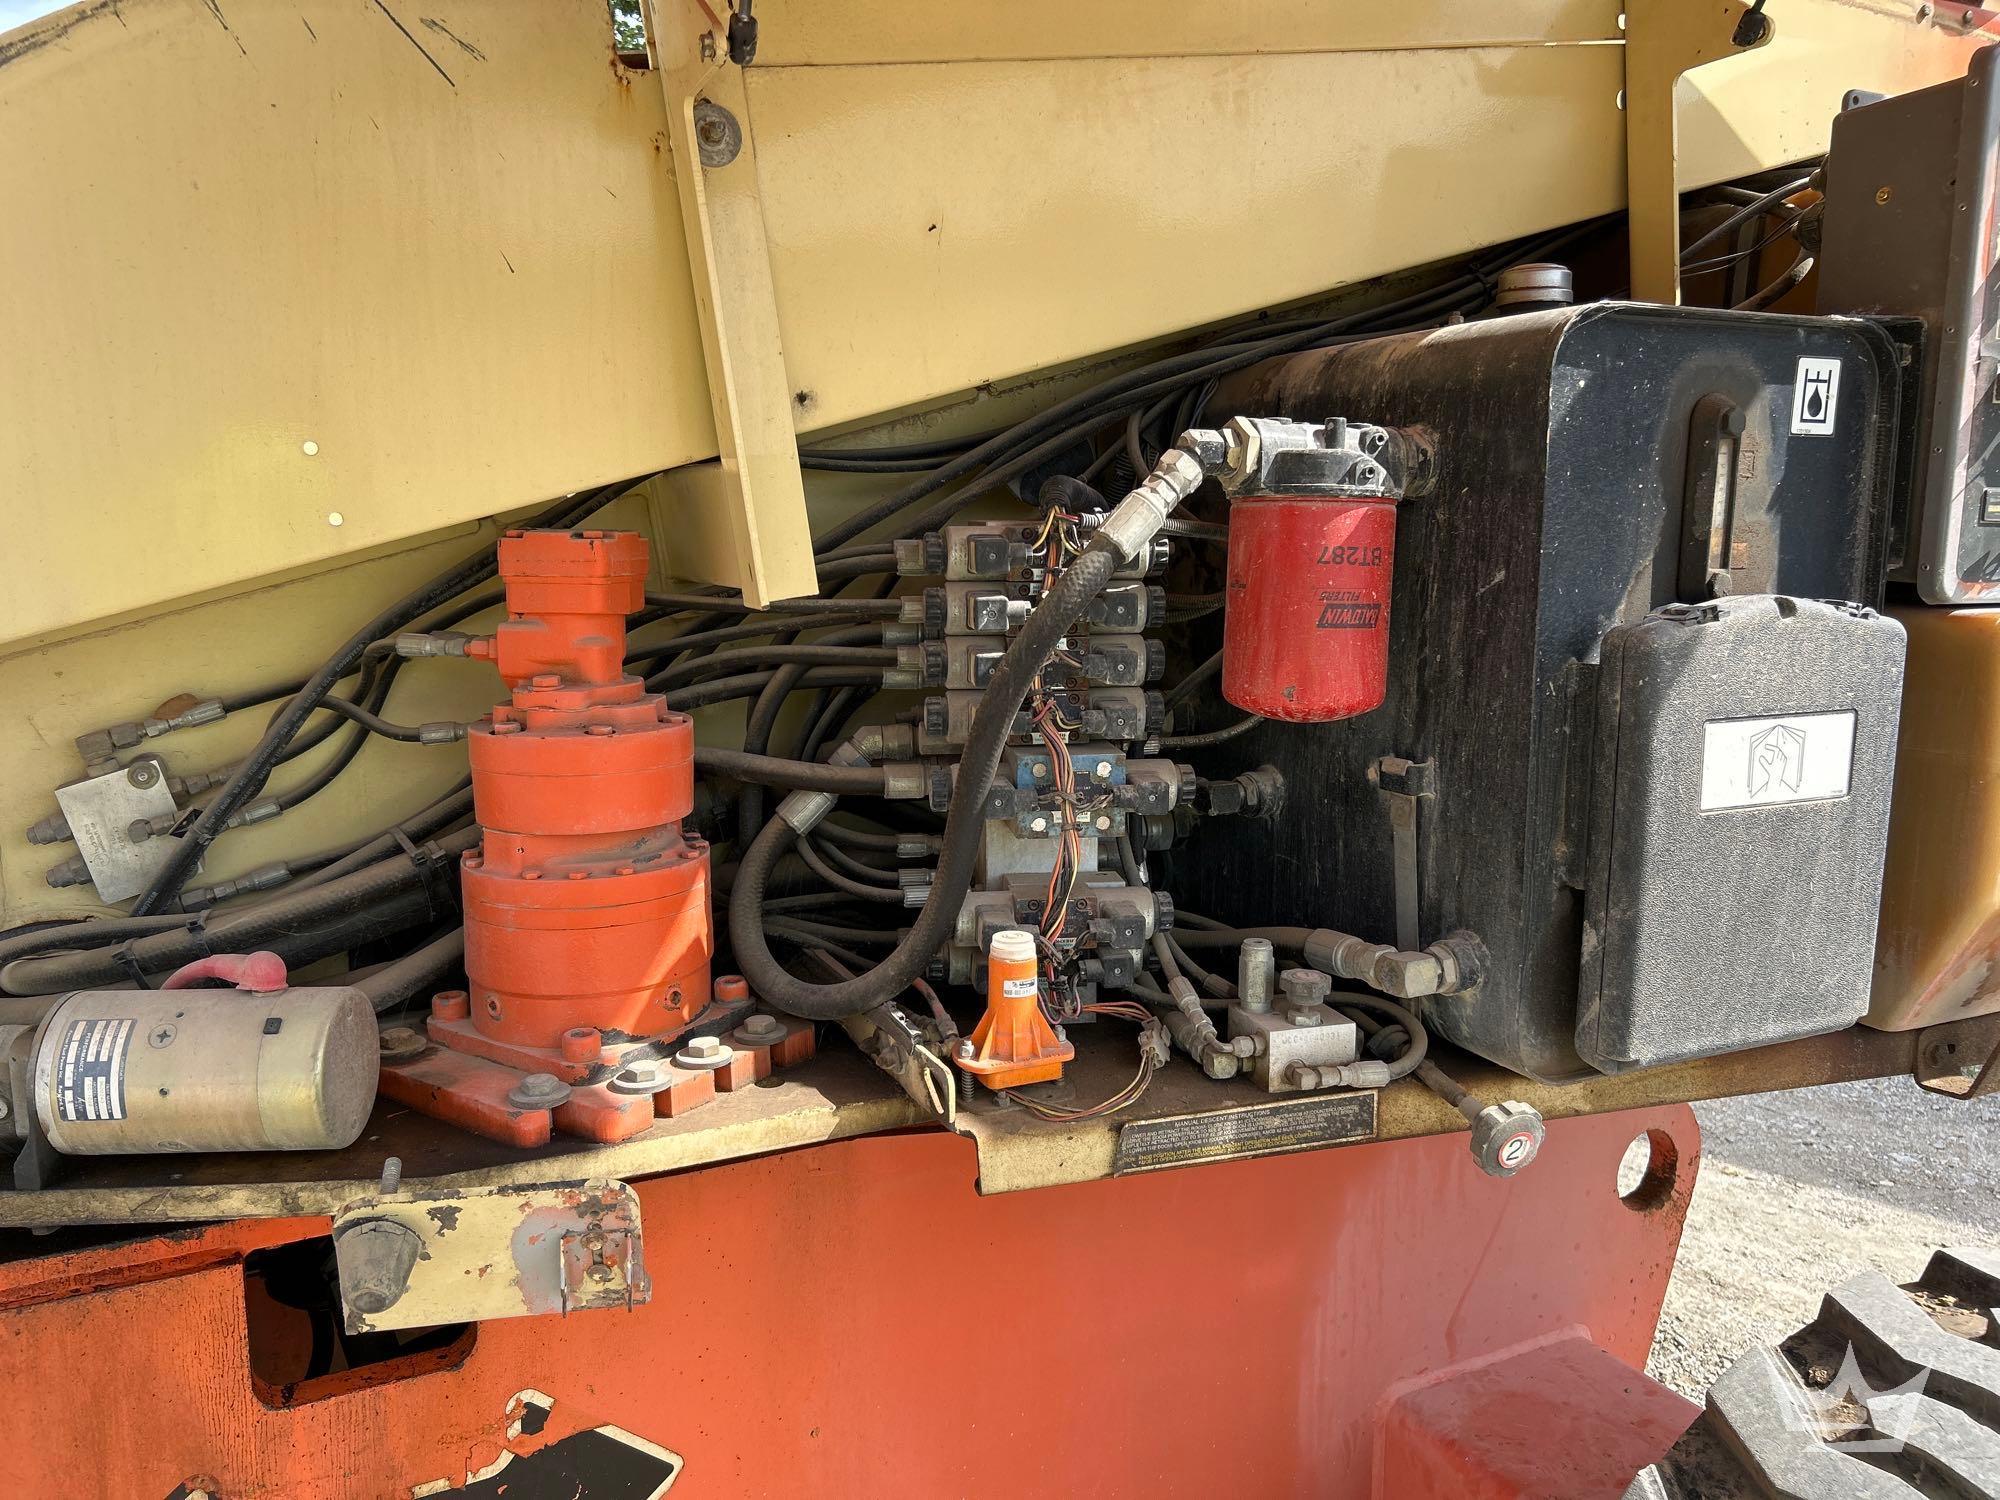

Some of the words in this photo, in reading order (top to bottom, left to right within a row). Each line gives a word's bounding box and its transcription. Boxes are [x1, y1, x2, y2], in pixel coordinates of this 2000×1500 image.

[1317, 545, 1382, 566] BT287
[1319, 591, 1361, 602] FILTERS
[1322, 607, 1379, 625] BALDWIN
[79, 1032, 91, 1072] PERFORMANCE
[1174, 1118, 1199, 1126] MANUAL
[1200, 1114, 1226, 1123] DESCENT
[1228, 1109, 1270, 1119] INSTRUCTIONS
[1245, 1137, 1270, 1145] OPERATION
[1505, 1138, 1524, 1162] 2
